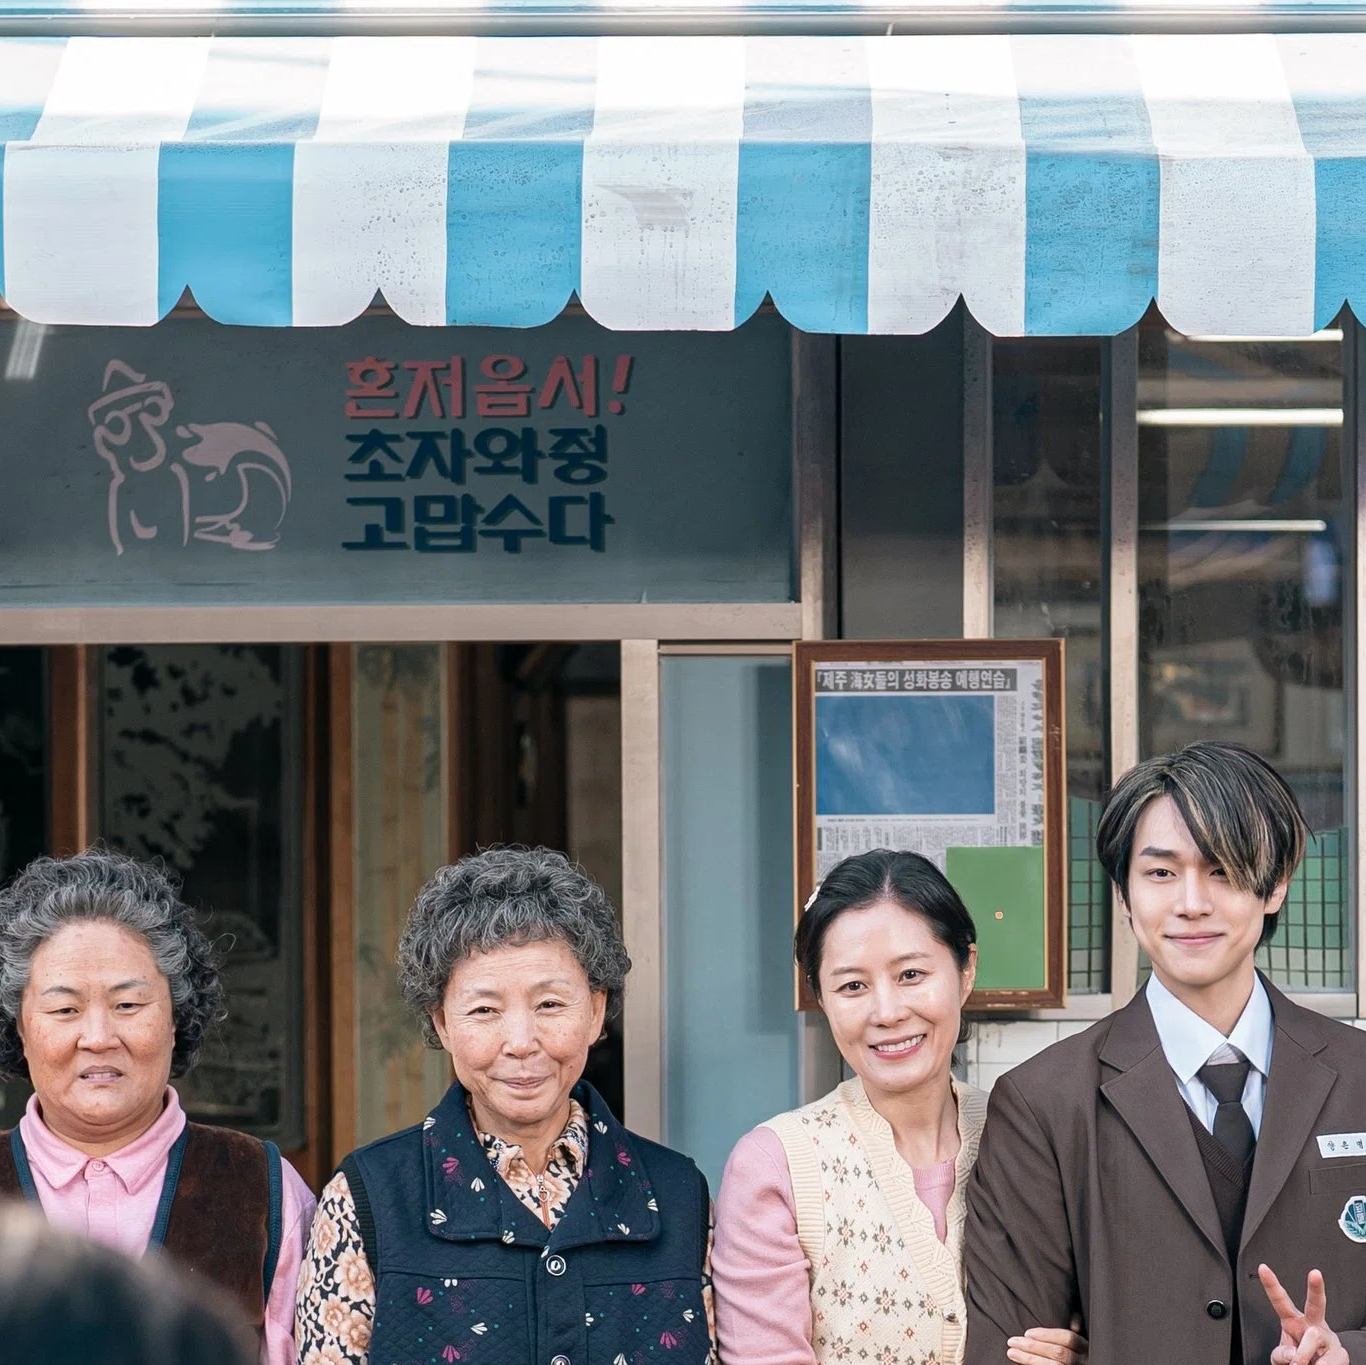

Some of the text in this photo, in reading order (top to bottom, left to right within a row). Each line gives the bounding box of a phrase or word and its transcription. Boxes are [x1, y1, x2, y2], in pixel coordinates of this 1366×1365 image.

[344, 354, 635, 419] 혼저옵서!
[341, 491, 615, 553] 고맙수다
[850, 670, 900, 690] 海女들의
[903, 670, 952, 690] 성화봉송
